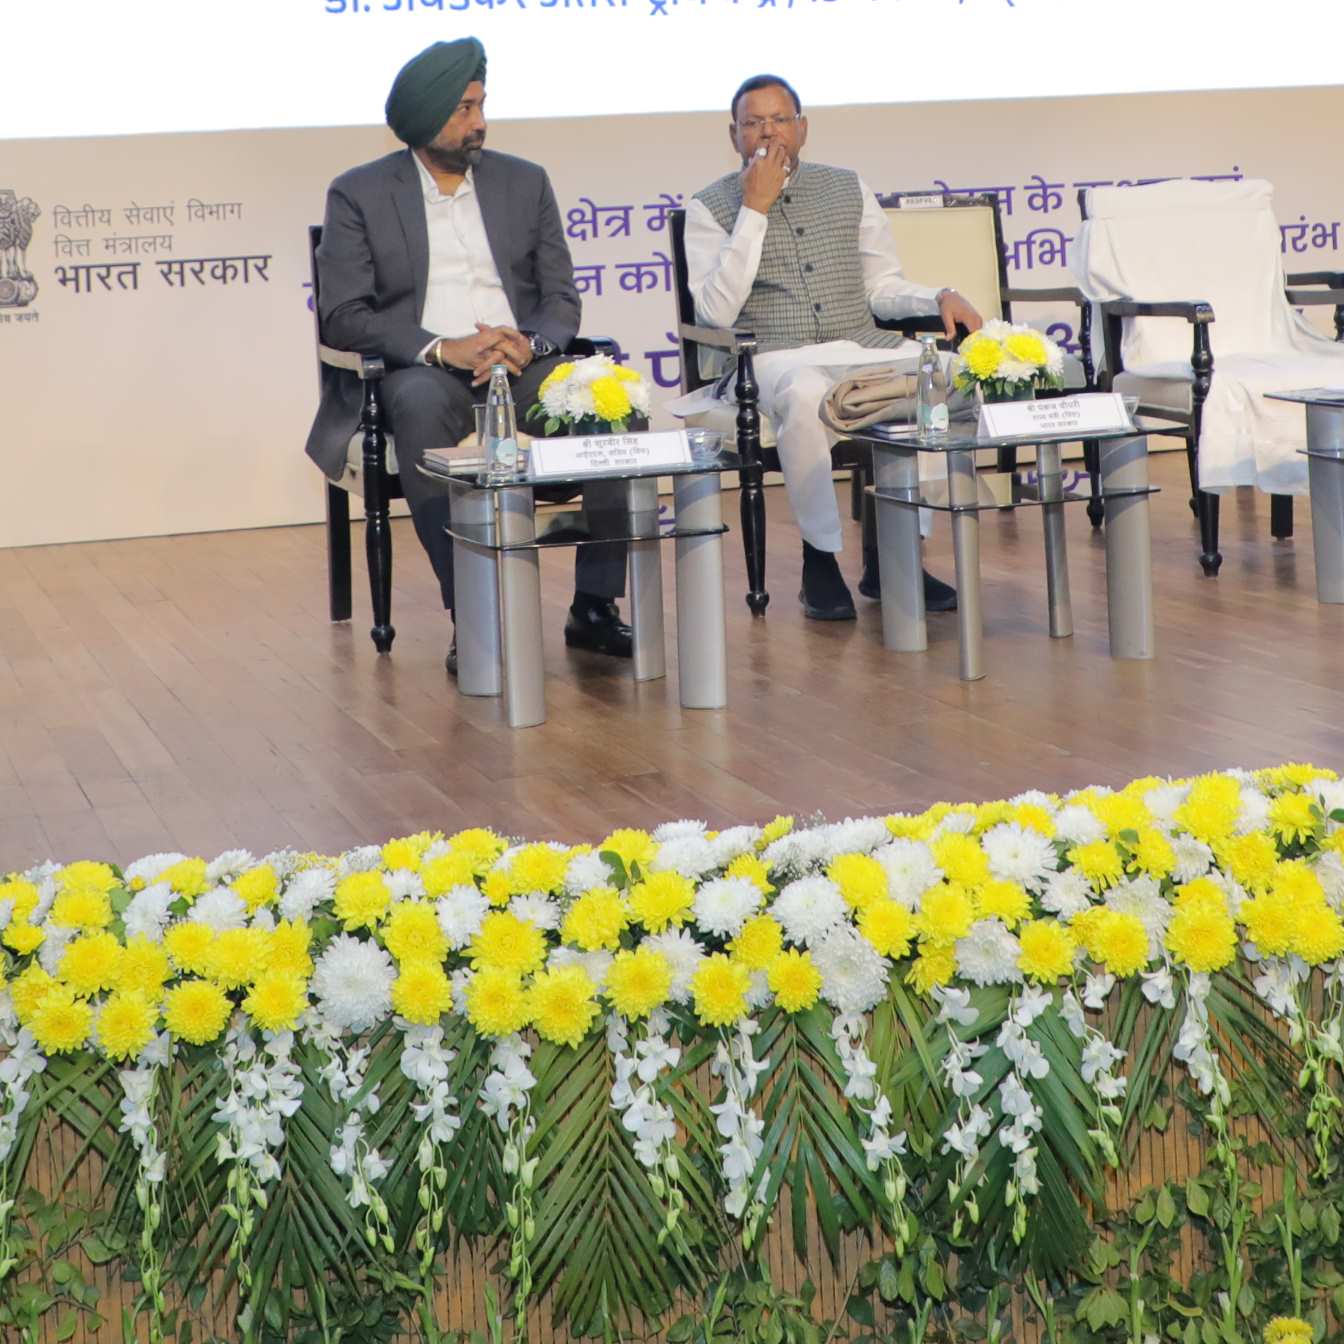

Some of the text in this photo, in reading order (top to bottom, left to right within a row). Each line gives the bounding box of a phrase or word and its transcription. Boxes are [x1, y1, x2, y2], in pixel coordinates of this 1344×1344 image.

[53, 198, 242, 230] वित्तीय सेवाएं विभाग
[1024, 175, 1070, 214] के
[566, 197, 634, 241] क्षेत्र
[54, 232, 174, 258] वित्त मंत्रालय
[56, 254, 272, 294] भारत सरकार
